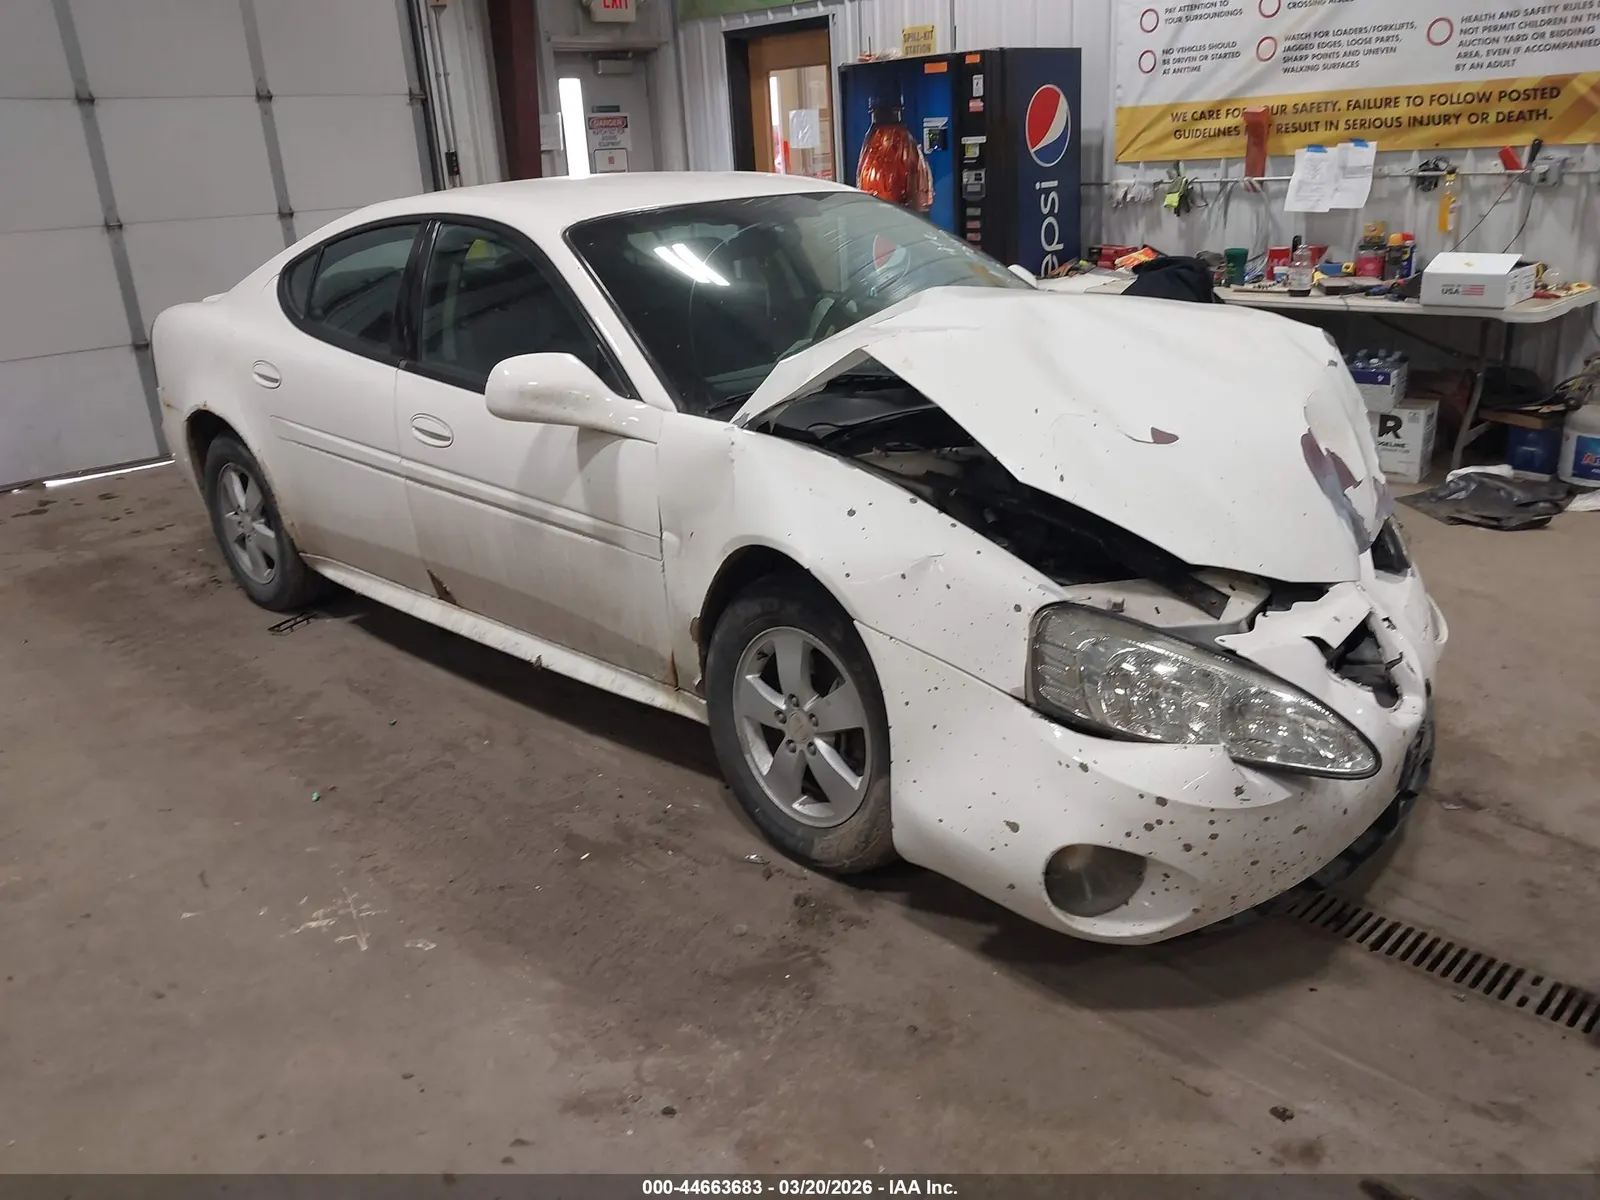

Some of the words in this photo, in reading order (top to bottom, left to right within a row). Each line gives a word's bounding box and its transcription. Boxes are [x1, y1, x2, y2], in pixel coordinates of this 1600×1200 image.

[1164, 7, 1177, 15] PAY
[1178, 2, 1218, 13] ATTENTION
[1286, 0, 1327, 10] CROSSING
[1460, 13, 1496, 24] HEALTH
[1498, 9, 1521, 20] AND
[1523, 4, 1560, 17] SAFETY
[1562, 0, 1594, 12] RULES
[1164, 15, 1184, 24] YOUR
[1185, 8, 1243, 22] SURROUNDINGS
[1460, 26, 1480, 36] NOT
[1482, 22, 1516, 34] PERMIT
[1518, 16, 1568, 30] CHILDREN
[1570, 13, 1584, 23] IN
[1586, 11, 1600, 21] TH
[1284, 32, 1311, 42] WATCH
[1313, 30, 1330, 39] FOR
[1332, 21, 1418, 37] LOADERS/FORKLIFTS,
[1457, 36, 1500, 48] AUCTION
[1503, 33, 1529, 43] YARD
[1531, 31, 1546, 40] OR
[1549, 25, 1597, 39] BIDDING
[1162, 47, 1175, 56] NO
[1176, 44, 1207, 54] VEHICLES
[1208, 41, 1238, 51] SHOULD
[1282, 42, 1315, 53] JAGGED
[1317, 40, 1345, 50] EDGES,
[1346, 37, 1373, 47] LOOSE
[1374, 34, 1403, 44] PARTS,
[1485, 47, 1511, 58] EVEN
[1513, 46, 1522, 55] IF
[1524, 38, 1600, 54] ACCOMPANIED
[1162, 58, 1171, 66] BE
[1172, 55, 1198, 65] DRIVEN
[1199, 54, 1209, 62] OR
[1211, 51, 1242, 61] STARTED
[1282, 53, 1310, 64] SHARP
[1311, 51, 1341, 60] POINTS
[1342, 49, 1361, 58] AND
[1363, 46, 1397, 56] UNEVEN
[1162, 68, 1171, 76] AT
[1172, 65, 1202, 75] ANYTIME
[1282, 64, 1320, 74] WALKING
[1322, 60, 1360, 71] SURFACES
[1454, 63, 1467, 72] BY
[1468, 62, 1484, 71] AN
[1485, 59, 1518, 70] ADULT
[1170, 111, 1188, 124] WE
[1190, 109, 1221, 122] CARE
[1292, 100, 1342, 115] SAFETY.
[1346, 95, 1401, 111] FAILURE
[1405, 94, 1424, 108] TO
[1428, 91, 1493, 106] FOLLOW
[1499, 86, 1561, 102] POSTED
[1173, 125, 1241, 140] GUIDELINES
[1275, 120, 1320, 135] RESULT
[1324, 119, 1340, 132] IN
[1343, 115, 1402, 131] SERIOUS
[1407, 112, 1464, 128] INJURY
[1467, 111, 1490, 125] OR
[1495, 108, 1554, 124] DEATH.
[1035, 180, 1064, 279] epsi
[1441, 287, 1461, 296] USA
[1378, 414, 1403, 439] R
